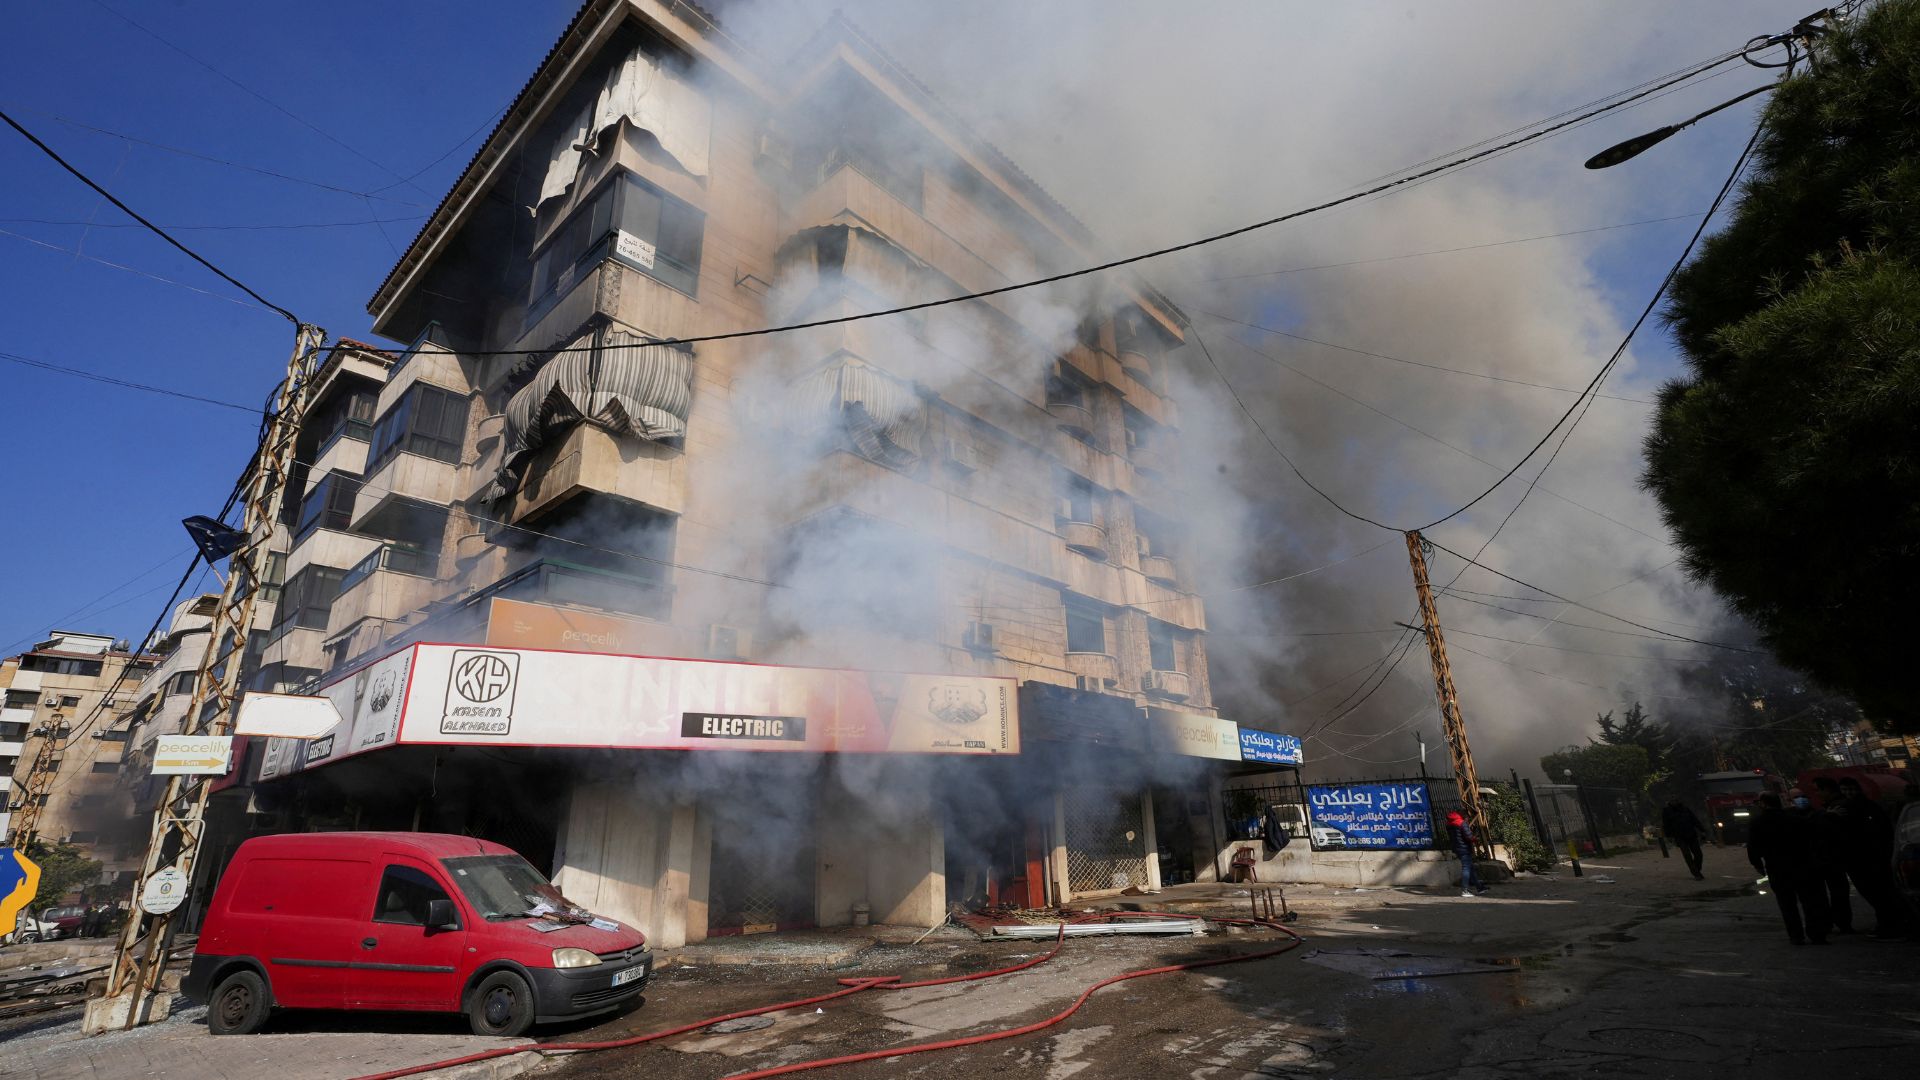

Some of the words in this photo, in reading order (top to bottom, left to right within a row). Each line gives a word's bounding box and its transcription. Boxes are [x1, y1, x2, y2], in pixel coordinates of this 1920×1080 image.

[443, 721, 507, 732] ALKHALED
[703, 717, 784, 737] ELECTRIC
[158, 741, 230, 756] peacelily
[1241, 733, 1274, 750] بعلبكي
[1276, 737, 1295, 751] كاراج
[1312, 789, 1373, 809] بعلبكي
[1380, 787, 1423, 810] كاراج
